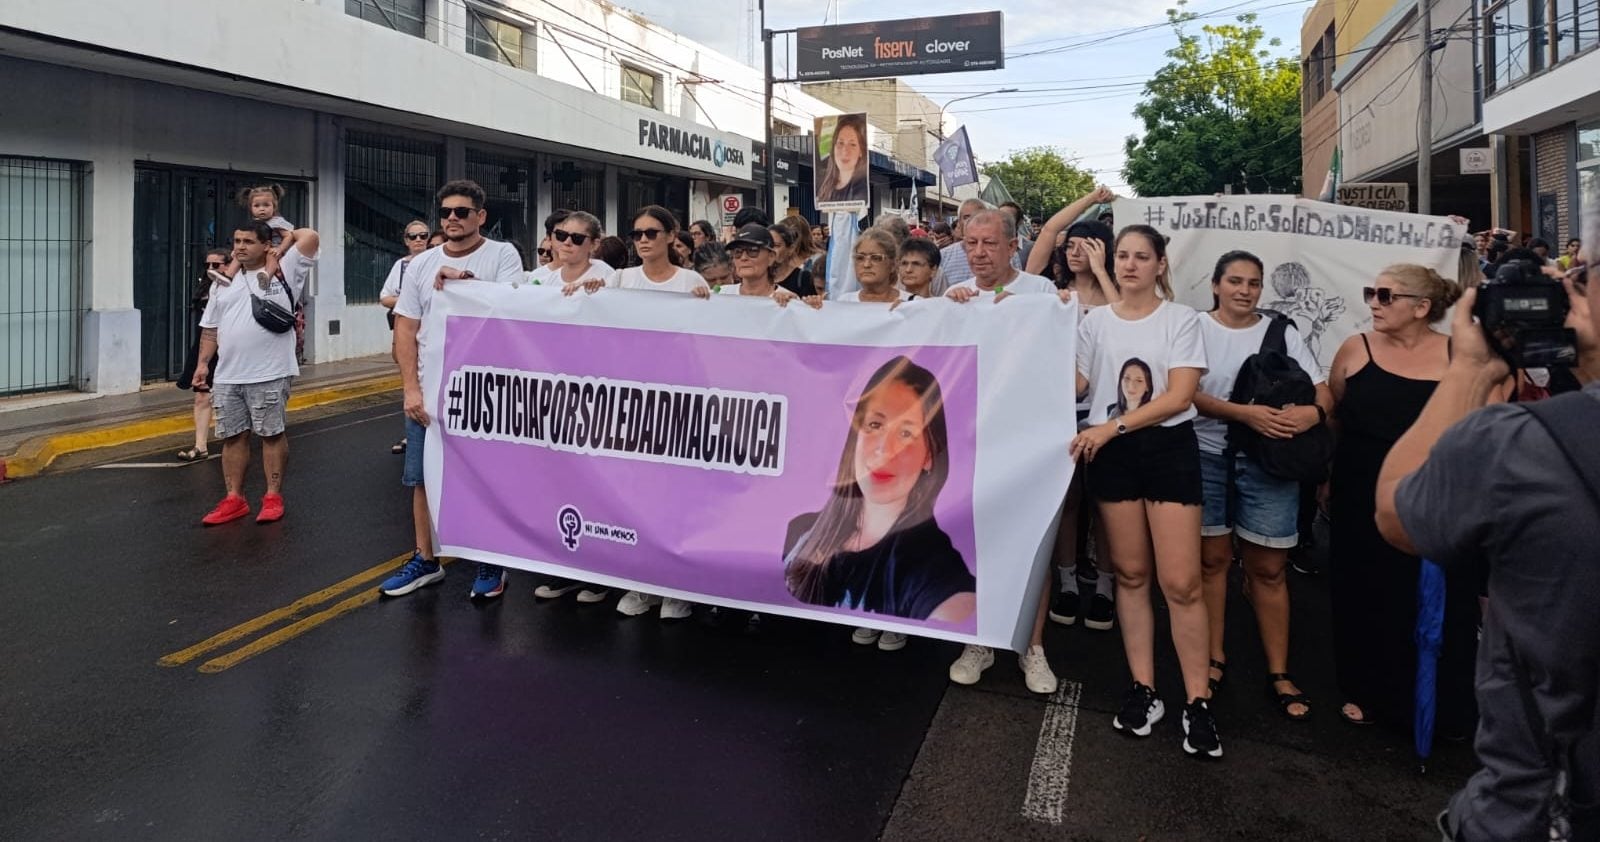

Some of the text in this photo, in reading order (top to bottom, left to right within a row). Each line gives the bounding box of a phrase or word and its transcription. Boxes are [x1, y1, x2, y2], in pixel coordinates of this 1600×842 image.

[822, 46, 863, 59] PosNet
[925, 40, 970, 53] clover
[639, 119, 712, 160] FARMACIA
[448, 371, 783, 469] #JUSTICIAPORSOLEDADMACHUCA
[611, 528, 635, 542] MENOS
